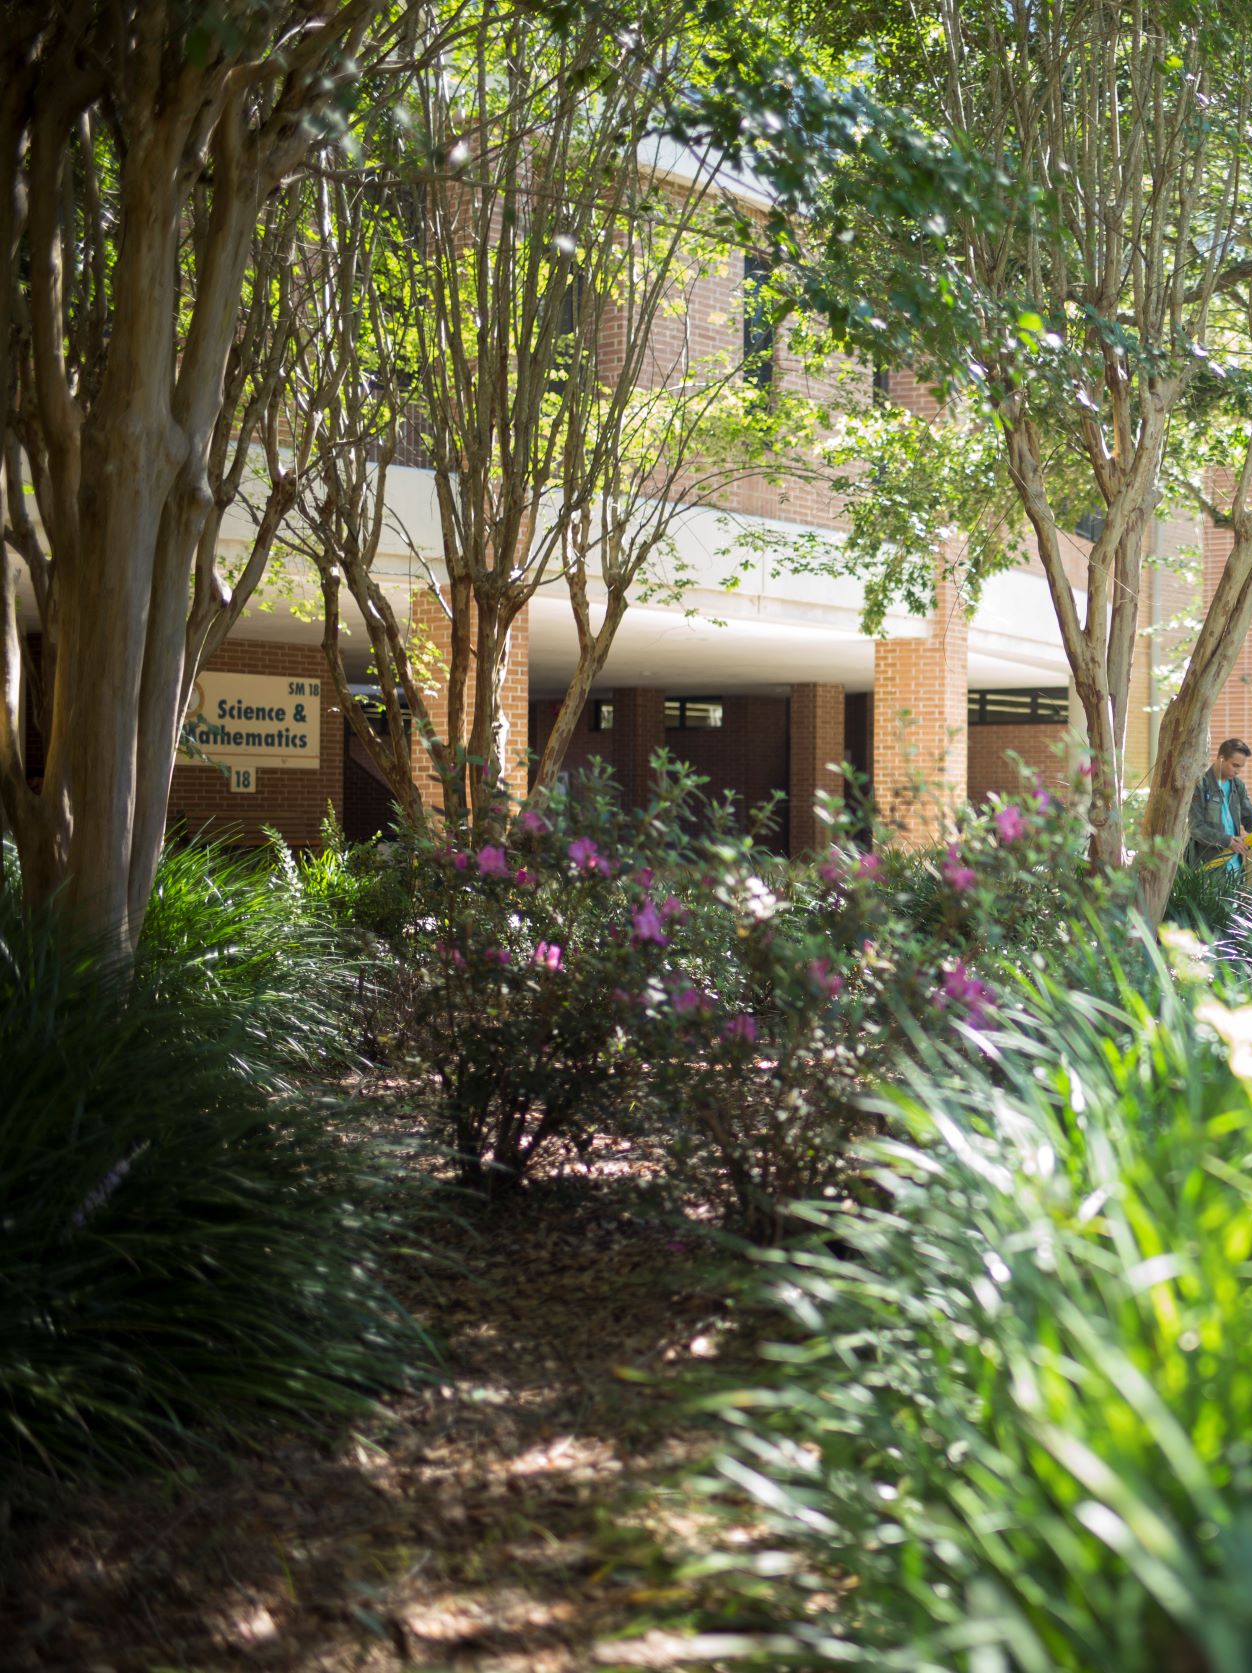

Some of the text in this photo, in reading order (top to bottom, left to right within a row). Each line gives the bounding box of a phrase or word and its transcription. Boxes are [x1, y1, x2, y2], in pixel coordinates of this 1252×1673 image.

[288, 681, 320, 697] SM 18
[218, 699, 307, 723] Science &
[235, 770, 250, 788] 18
